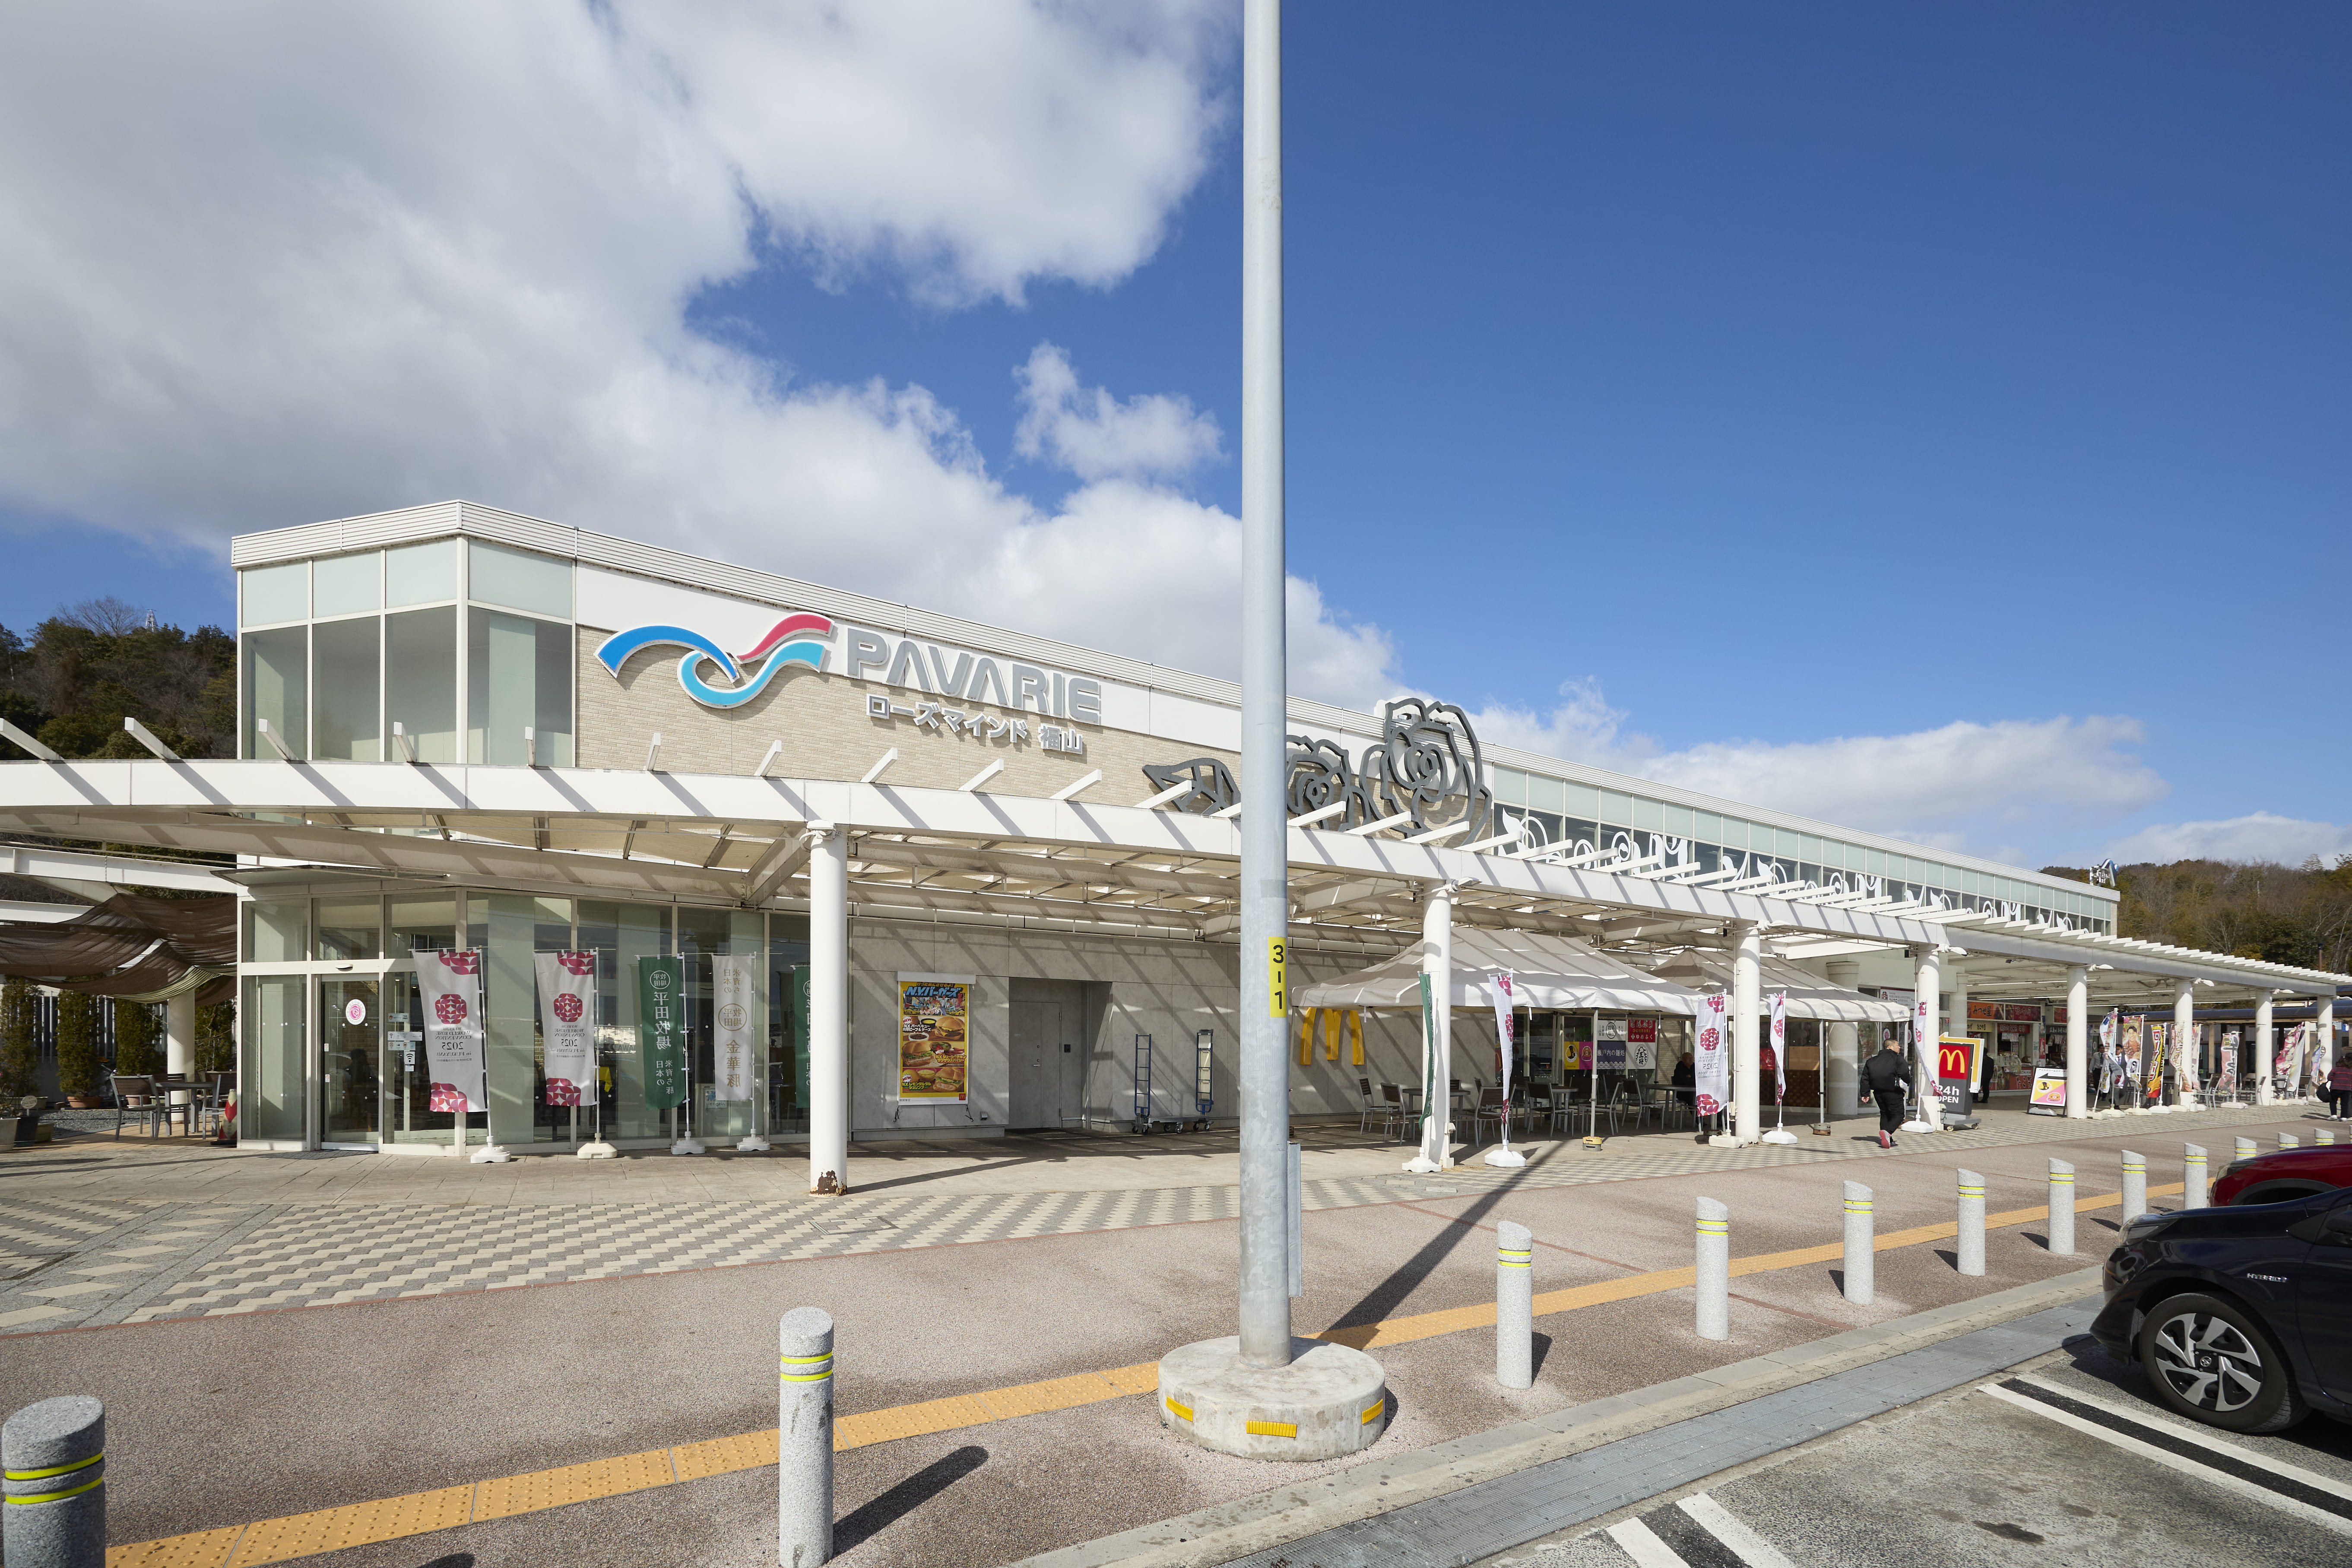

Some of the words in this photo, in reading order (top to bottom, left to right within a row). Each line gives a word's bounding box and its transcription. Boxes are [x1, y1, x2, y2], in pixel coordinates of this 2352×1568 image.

[847, 628, 1100, 725] PAVARIE
[867, 694, 1028, 744] ローズマインド
[1038, 723, 1083, 754] 福山
[2247, 1273, 2281, 1282] HYBRID
